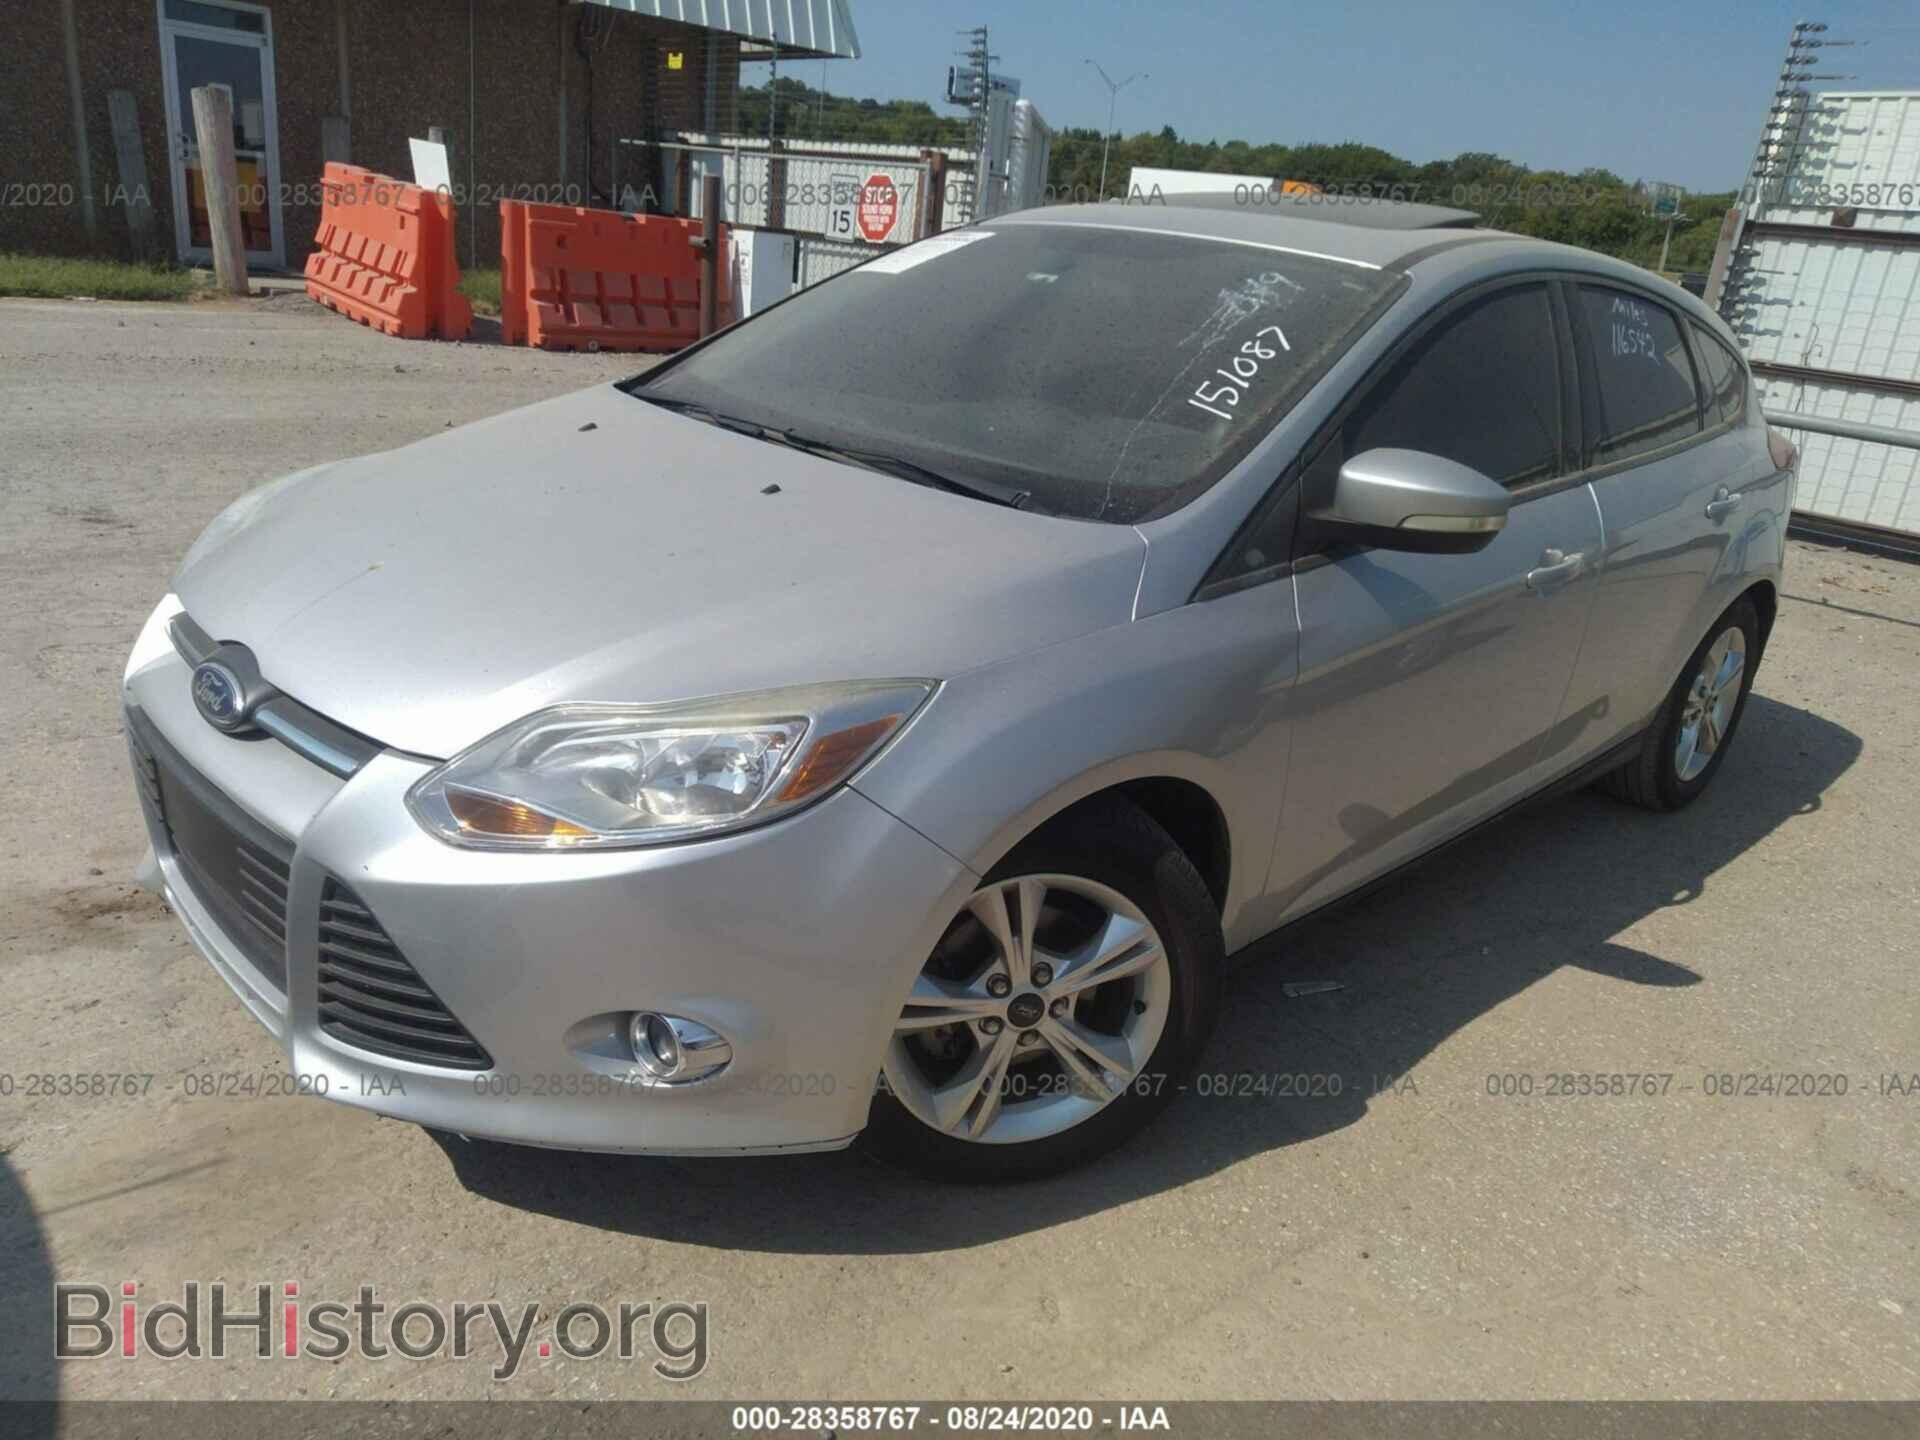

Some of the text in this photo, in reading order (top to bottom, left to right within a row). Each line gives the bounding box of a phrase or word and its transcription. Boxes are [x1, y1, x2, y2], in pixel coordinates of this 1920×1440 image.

[864, 185, 894, 204] STOP
[832, 209, 851, 233] 15
[1187, 325, 1291, 420] 151087
